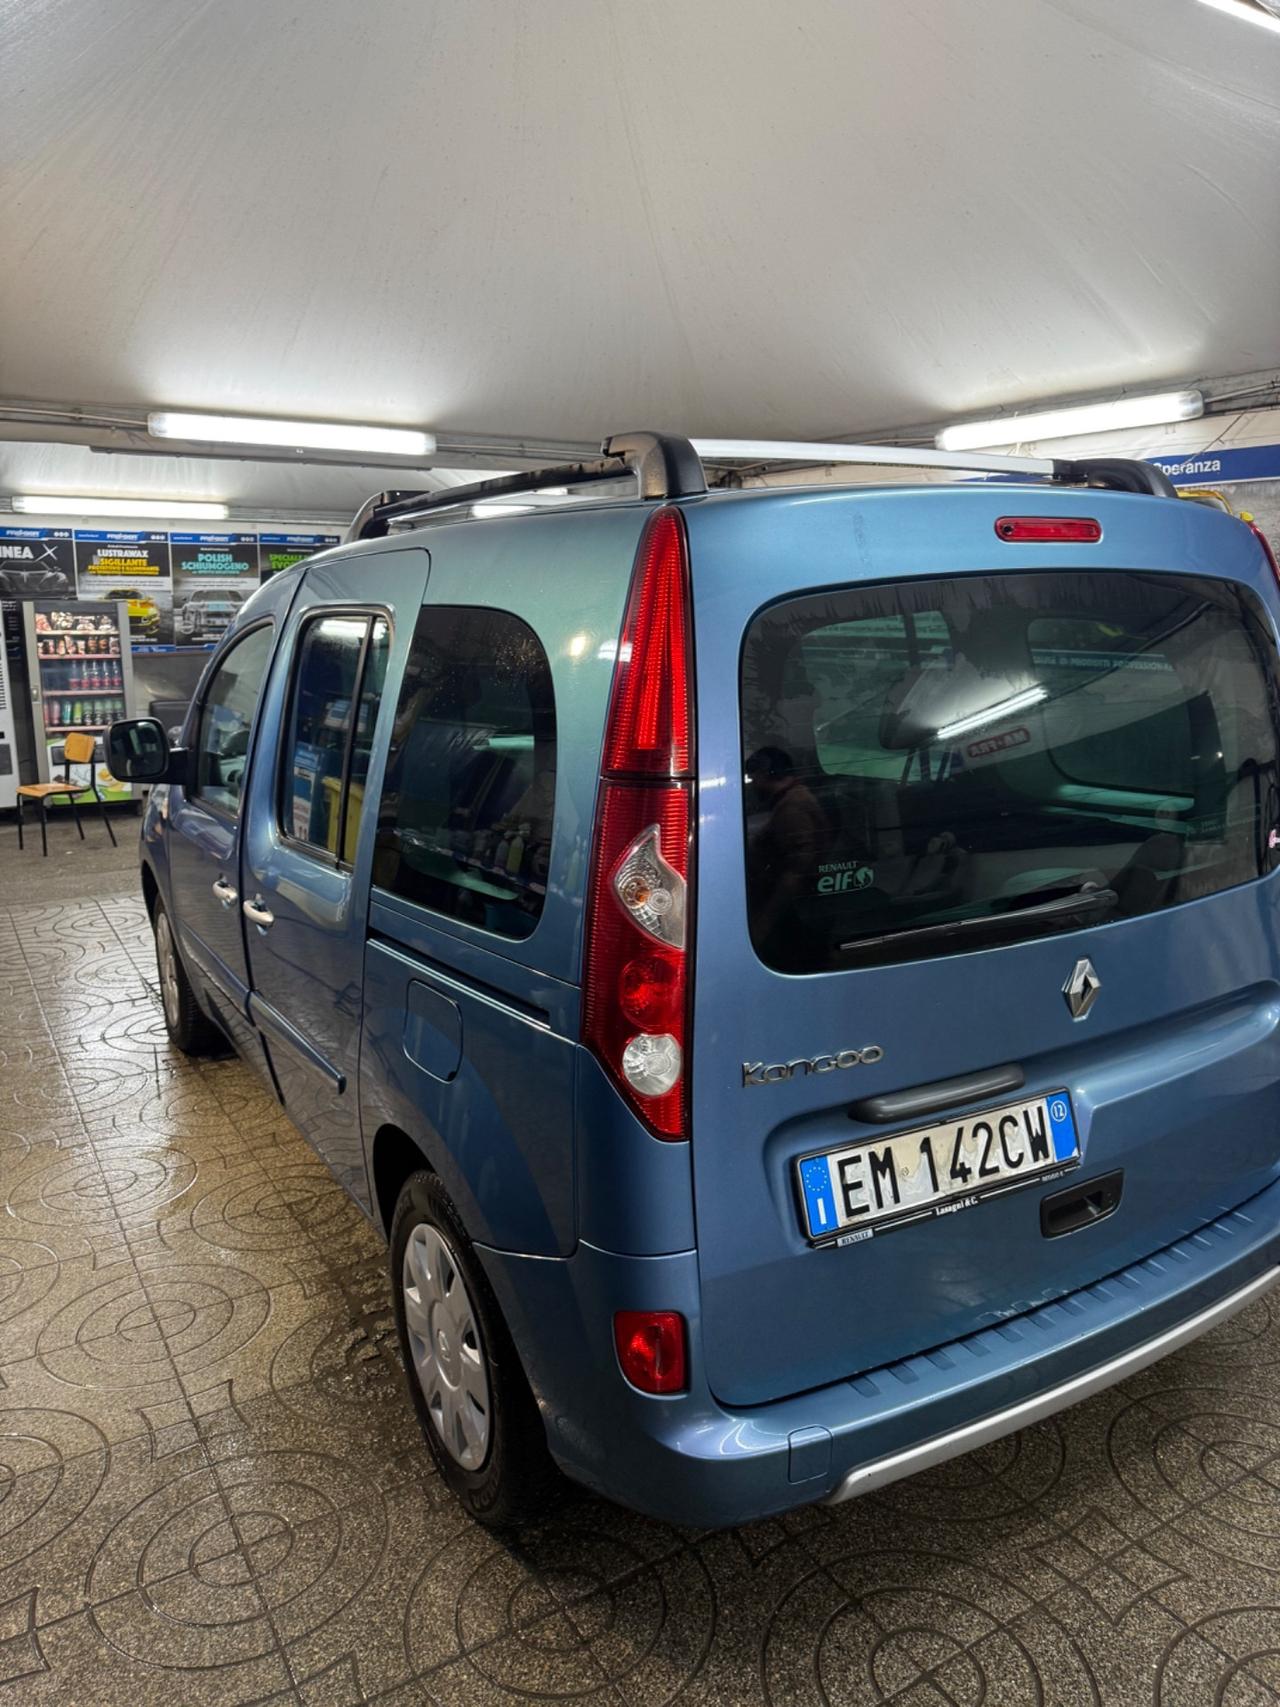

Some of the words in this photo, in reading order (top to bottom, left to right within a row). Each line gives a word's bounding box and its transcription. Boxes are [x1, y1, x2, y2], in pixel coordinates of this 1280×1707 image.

[97, 549, 149, 558] LUSTRAWAX
[198, 553, 233, 562] POLISH
[818, 861, 858, 872] RENAULT
[817, 871, 854, 892] elf
[1053, 1102, 1067, 1119] 12
[837, 1146, 900, 1218] EM
[920, 1105, 1051, 1193] 142CW
